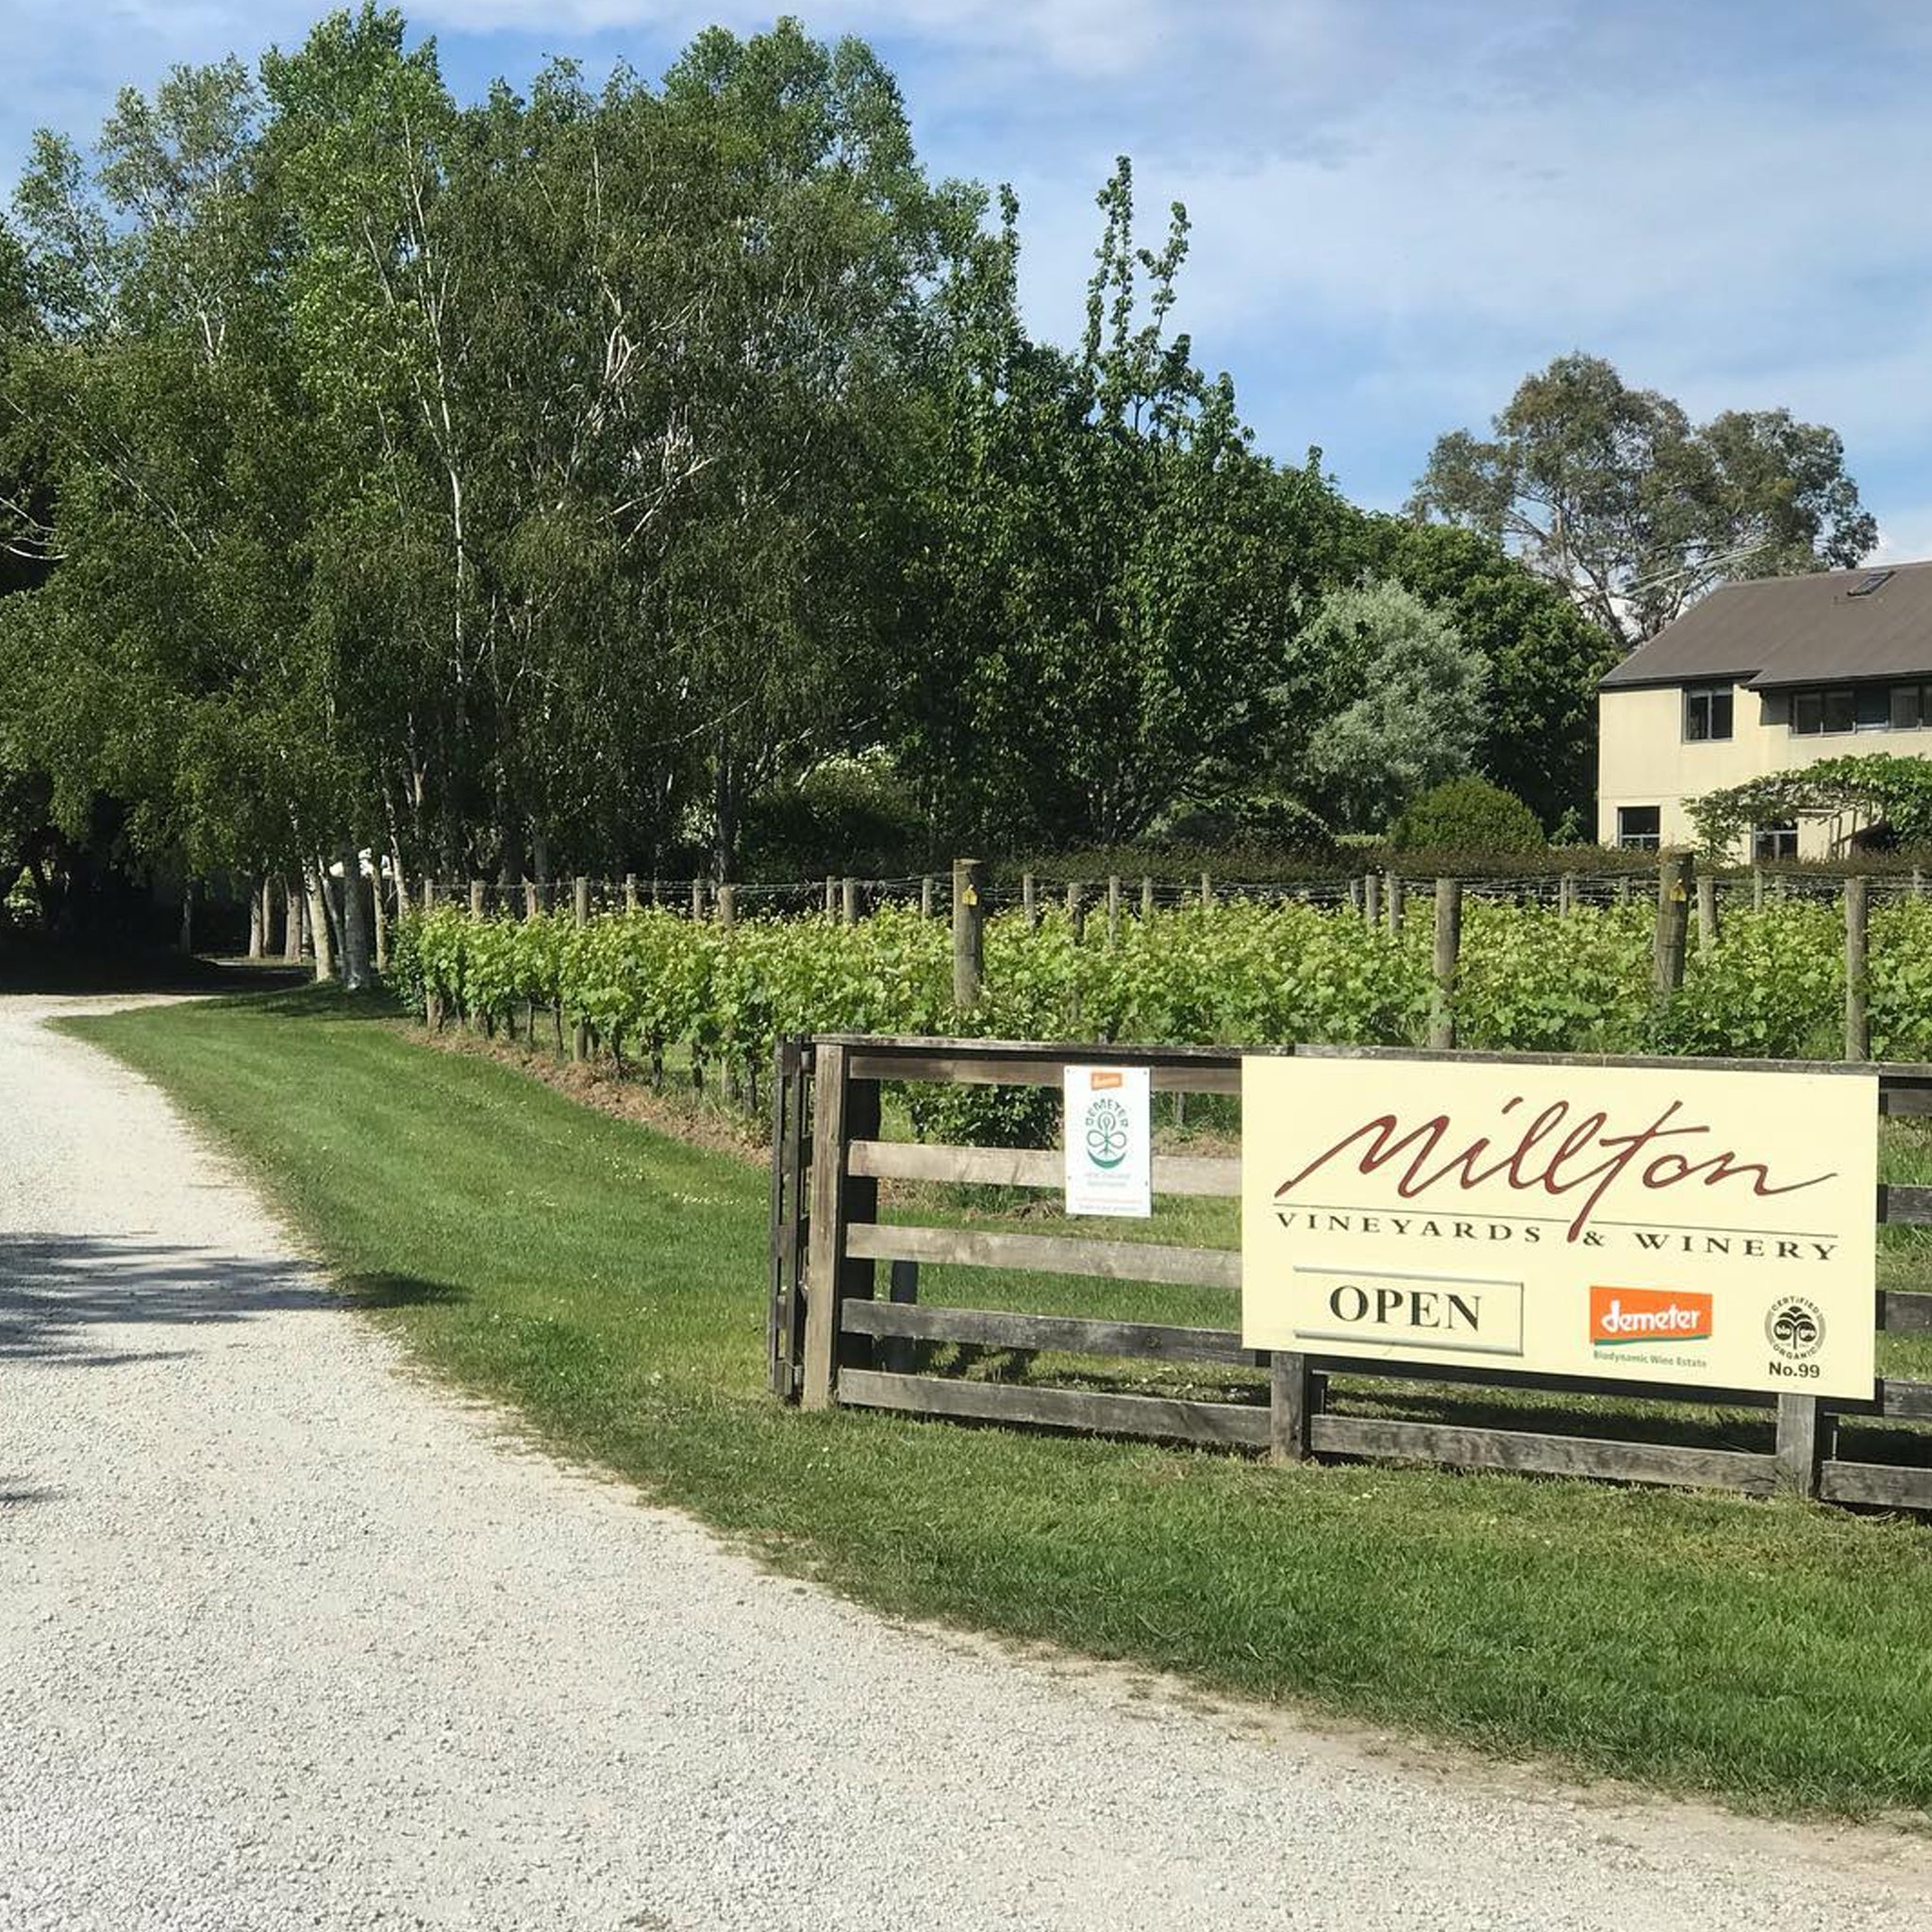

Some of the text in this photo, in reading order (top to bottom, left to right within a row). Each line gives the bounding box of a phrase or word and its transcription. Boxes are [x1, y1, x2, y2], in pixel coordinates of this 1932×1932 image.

[1086, 1098, 1129, 1127] DEMETER
[1274, 1096, 1839, 1242] Millton
[1276, 1212, 1838, 1261] VINEYARDS & WINERY
[1329, 1285, 1482, 1332] OPEN
[1601, 1300, 1701, 1333] demeter
[1771, 1295, 1820, 1314] CERTIFIED
[1593, 1350, 1707, 1368] Biodynamic Wine Estate
[1773, 1343, 1818, 1359] ORGANIC
[1769, 1360, 1821, 1378] No.99
